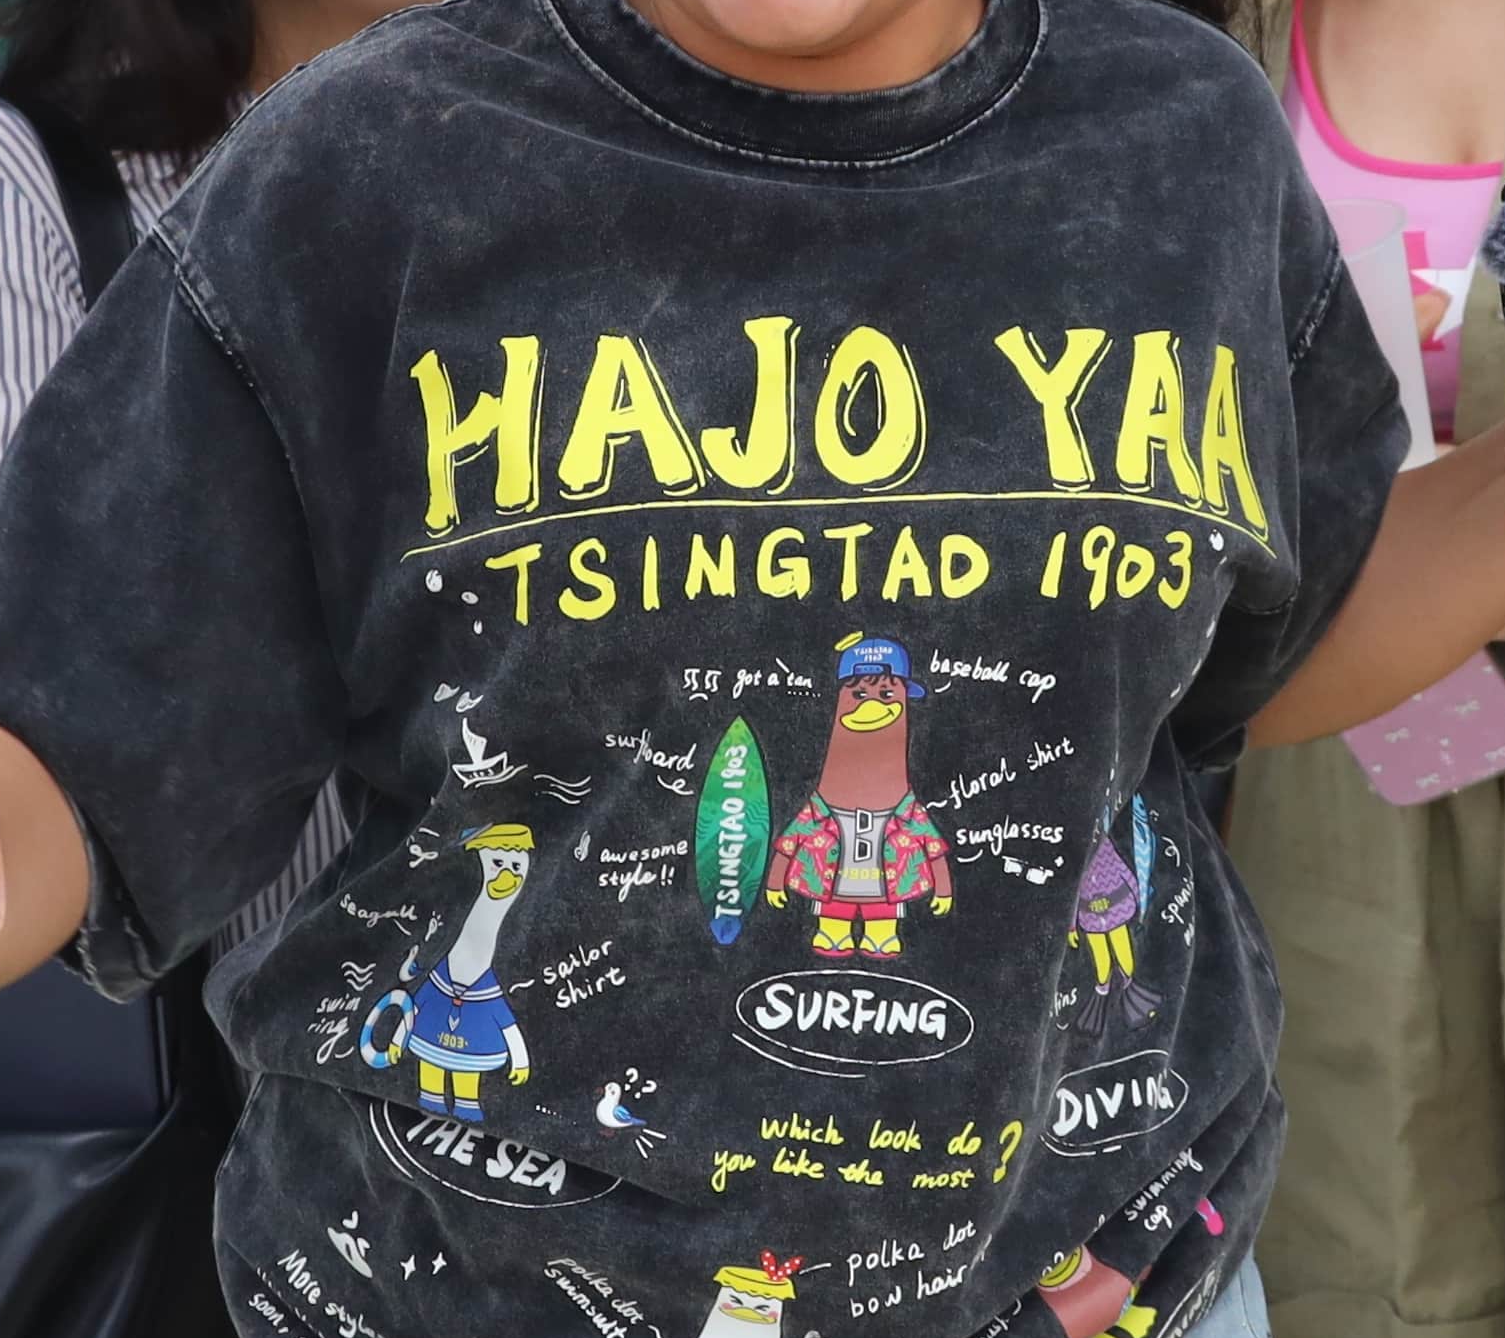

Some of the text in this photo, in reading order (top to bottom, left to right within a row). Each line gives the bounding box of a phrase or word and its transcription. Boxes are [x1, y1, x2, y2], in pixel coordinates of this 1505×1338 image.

[409, 315, 1268, 541] HAJO YAA
[1039, 524, 1194, 611] 1903
[732, 668, 813, 700] got a tan
[929, 648, 1057, 704] baseball cap
[720, 743, 749, 790] 1903
[946, 736, 1076, 810] floral shirt
[599, 839, 689, 865] awesome
[955, 814, 1065, 856] sunglasses
[542, 939, 614, 986] sailor
[316, 992, 362, 1014] swim
[555, 965, 627, 1010] shirt
[754, 982, 948, 1041] SURFING
[868, 1118, 923, 1153] look
[946, 1120, 983, 1157] do
[484, 1138, 568, 1196] SEA
[710, 1149, 757, 1193] you
[771, 1146, 826, 1180] like
[837, 1158, 885, 1187] the
[911, 1169, 976, 1190] most
[1143, 1203, 1174, 1232] cap
[276, 1247, 323, 1305] More
[845, 1237, 926, 1288] polka
[942, 1219, 978, 1251] dot
[546, 1257, 645, 1325] polka dot
[850, 1284, 903, 1319] bow
